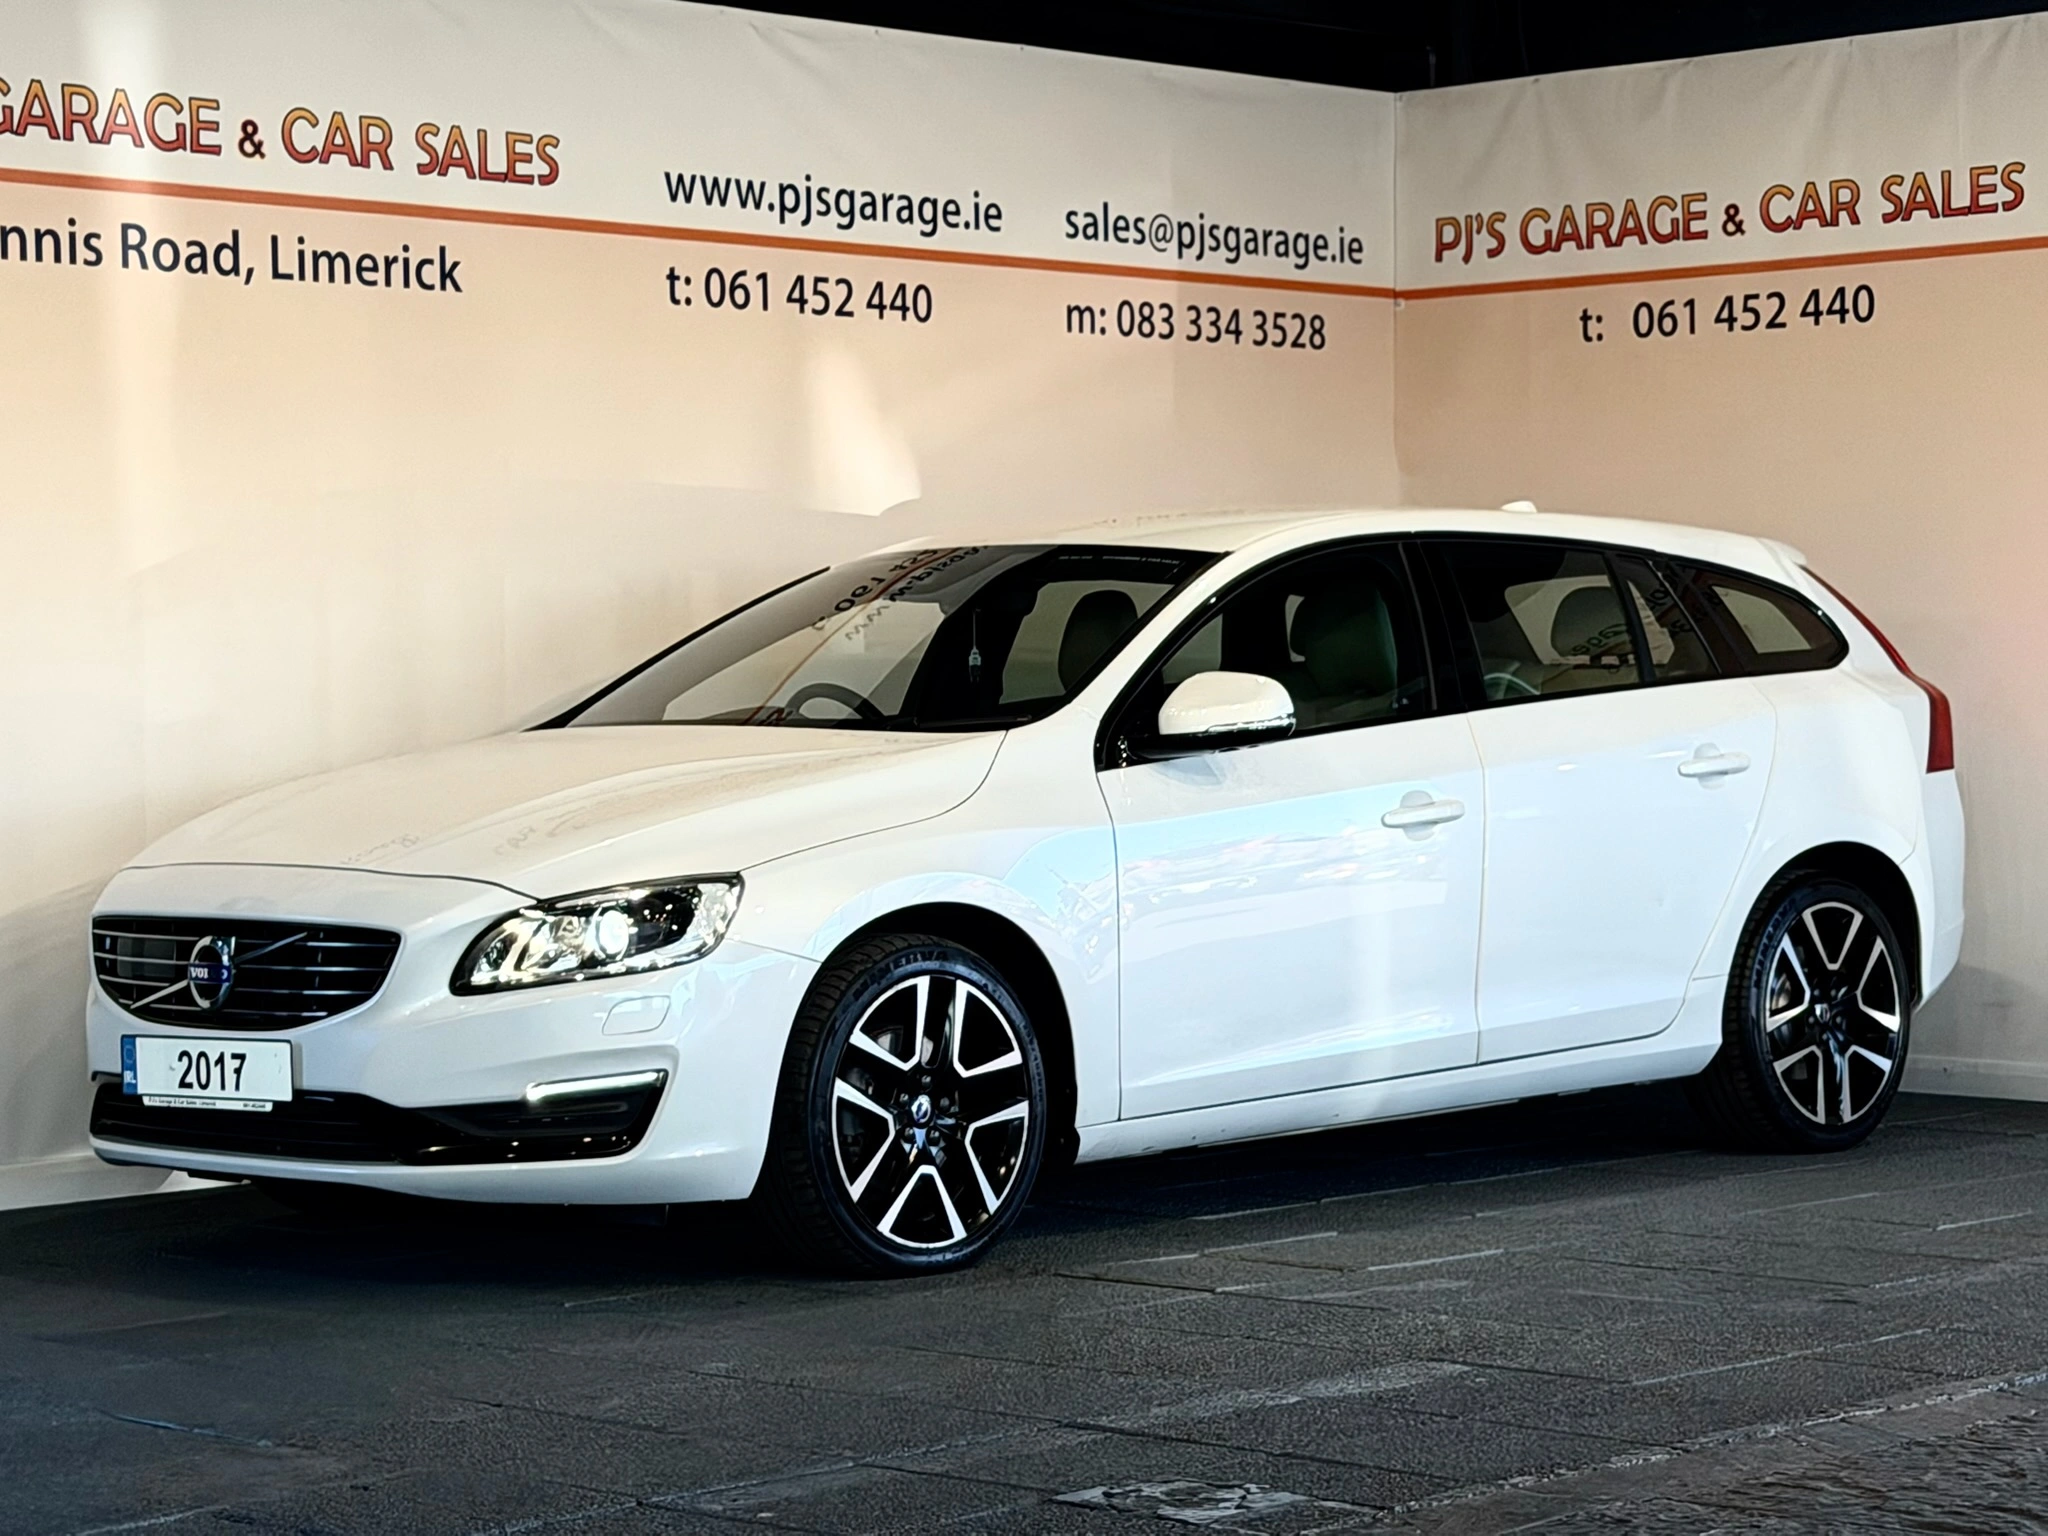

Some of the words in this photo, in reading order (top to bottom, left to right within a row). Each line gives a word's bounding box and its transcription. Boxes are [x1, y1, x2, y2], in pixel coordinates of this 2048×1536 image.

[238, 119, 266, 159] &
[281, 107, 394, 171] CAR
[415, 123, 560, 186] SALES
[664, 172, 1003, 238] www.pjsgarage.ie
[1066, 201, 1364, 270] sales@pjsgarage.ie
[1435, 211, 1506, 264] PJ'S
[1519, 192, 1708, 256] GARAGE
[1722, 203, 1746, 236] &
[1759, 179, 1860, 233] CAR
[1880, 162, 2026, 225] SALES
[0, 217, 103, 267] nnis
[120, 222, 254, 286] Road,
[270, 233, 463, 294] Limerick
[665, 265, 692, 307] t:
[704, 266, 769, 312] 061
[785, 274, 855, 318] 452
[865, 280, 933, 324] 440
[1066, 303, 1107, 336] m:
[1116, 299, 1175, 341] 083
[1185, 304, 1244, 345] 334
[1252, 309, 1326, 351] 3528
[1579, 307, 1604, 343] t:
[1632, 297, 1696, 338] 061
[1713, 290, 1788, 333] 452
[1799, 283, 1875, 327] 440
[177, 1049, 248, 1092] 2017
